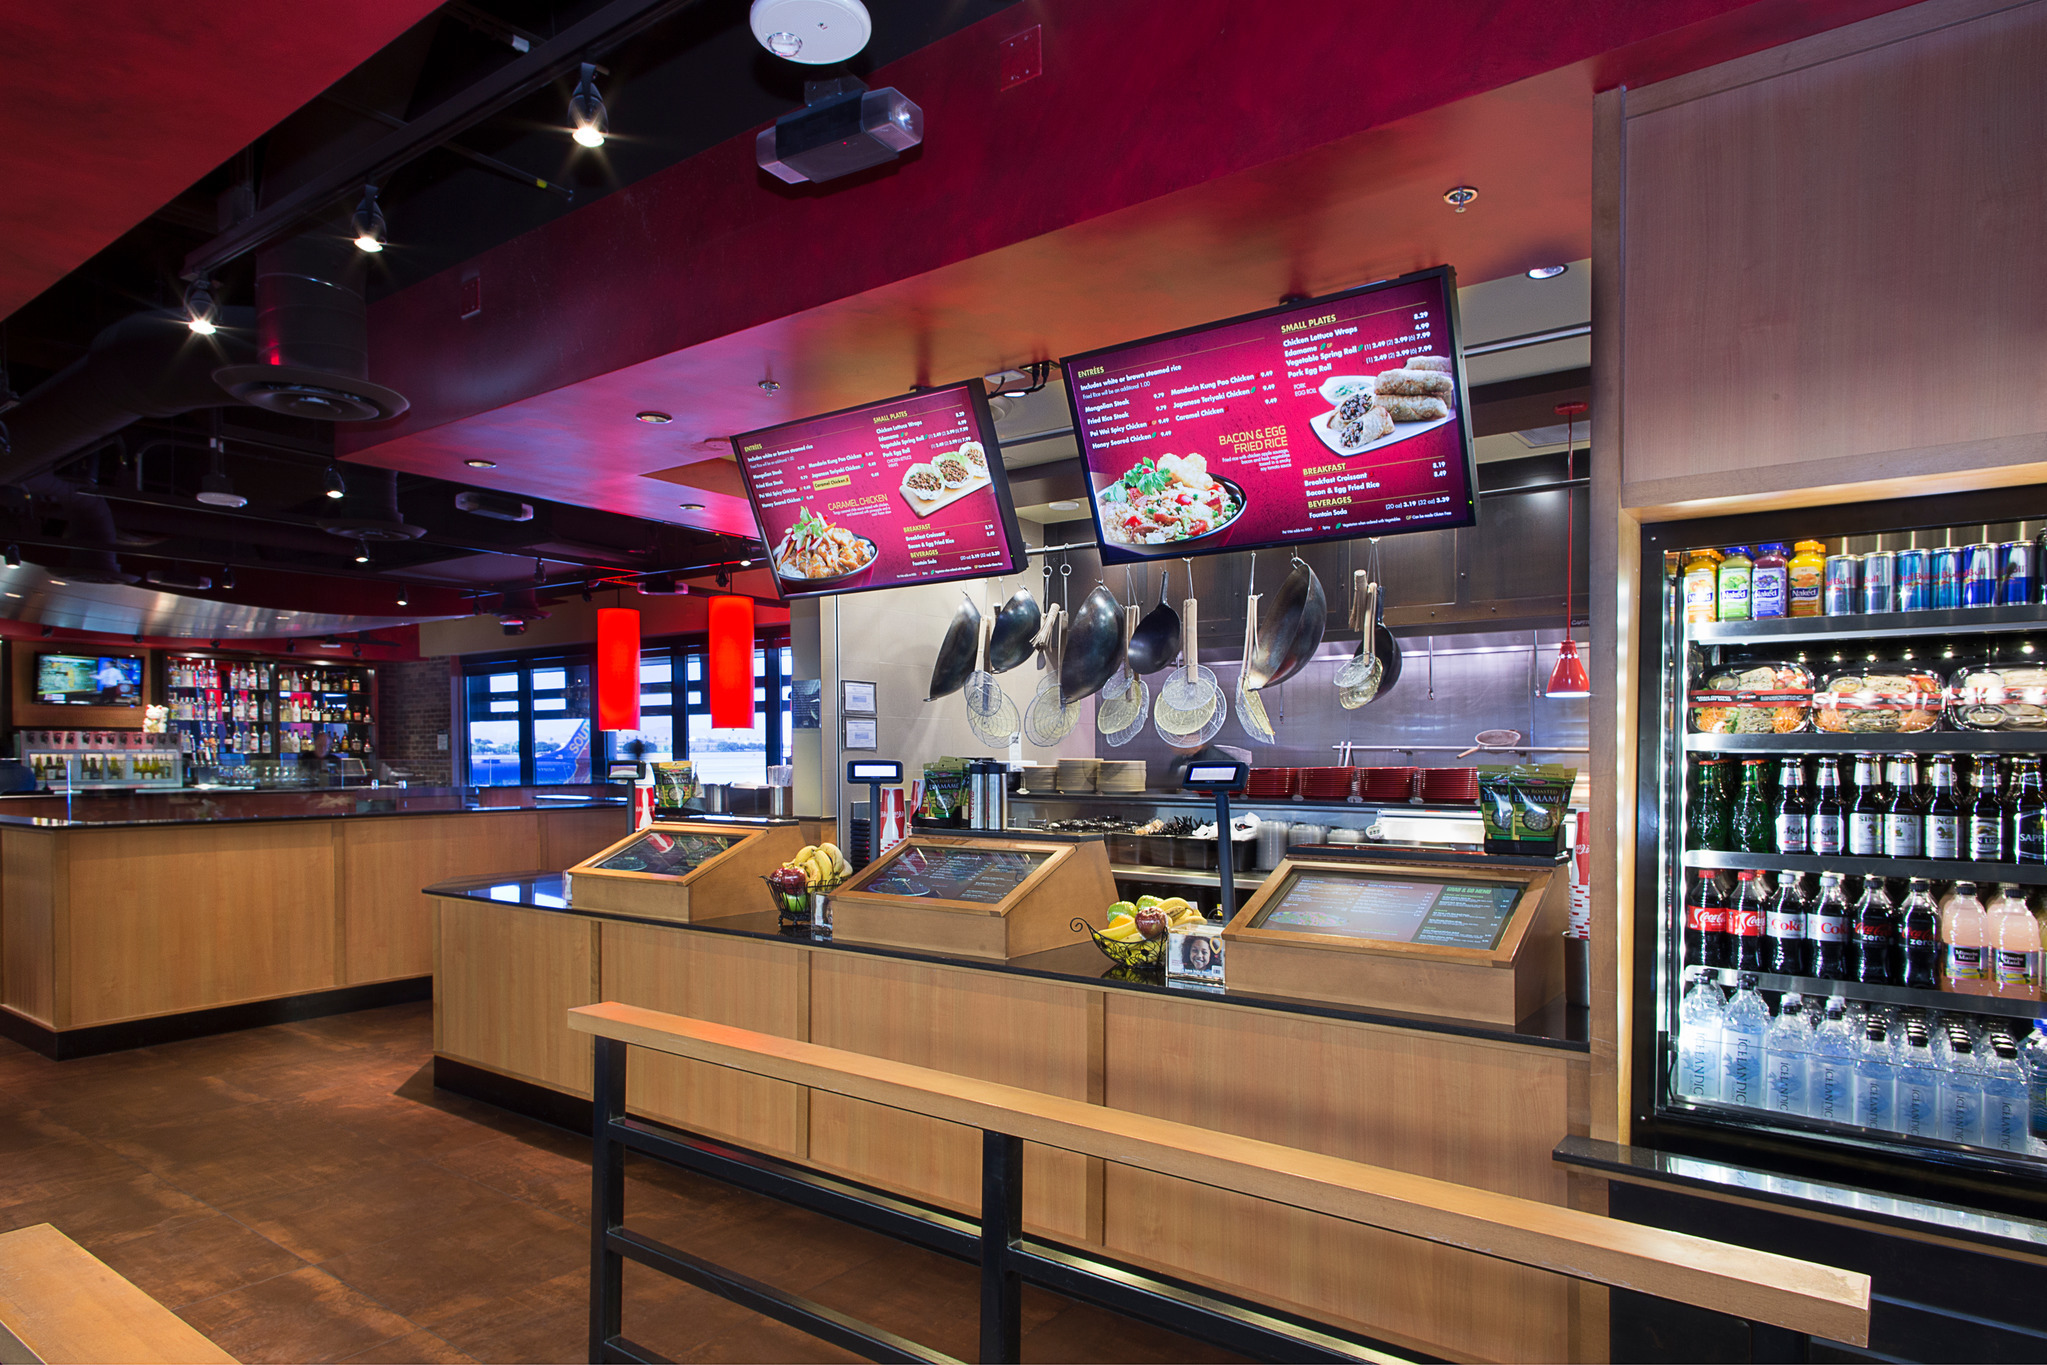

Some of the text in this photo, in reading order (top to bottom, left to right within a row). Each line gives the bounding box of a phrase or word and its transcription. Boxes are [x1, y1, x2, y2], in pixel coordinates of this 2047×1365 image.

[1414, 311, 1428, 320] 8.29
[1281, 314, 1336, 333] SMALL PLATES
[1415, 322, 1430, 330] 4.99
[1283, 327, 1358, 347] Chicken Lettuce Wraps
[1372, 341, 1386, 349] 2.49
[1394, 336, 1408, 344] 3.99
[1416, 331, 1431, 339] 7.99
[1285, 346, 1317, 357] Edamame
[1286, 346, 1357, 367] Vegetable Spring Roll
[1374, 354, 1387, 362] 2.49
[1396, 349, 1410, 357] 3.99
[1418, 345, 1432, 353] 7.99
[1080, 381, 1102, 391] Includes
[1103, 378, 1118, 386] white
[1126, 372, 1145, 381] brown
[1146, 366, 1169, 377] steamed
[1171, 364, 1182, 372] rice
[1288, 363, 1332, 378] Pork Egg Roll
[1171, 384, 1199, 396] Mandarin
[1200, 382, 1217, 390] Kung
[1217, 379, 1229, 387] Pao
[1230, 374, 1254, 384] Chicken
[1085, 403, 1114, 413] Mongolian
[1114, 398, 1130, 407] Steak
[1173, 399, 1200, 409] Japanese
[1201, 393, 1225, 403] Teriyaki
[1226, 389, 1250, 398] Chicken
[873, 411, 908, 423] SMALL PLATES
[1087, 417, 1101, 425] Fried
[1114, 411, 1129, 420] Steak
[1175, 411, 1200, 421] Caramel
[1200, 407, 1224, 416] Chicken
[1089, 430, 1098, 438] Pei
[1111, 426, 1125, 434] Spicy
[1125, 422, 1148, 431] Chicken
[1219, 425, 1286, 445] BACON & EGG
[1092, 441, 1110, 449] Honey
[1110, 437, 1129, 446] Seared
[1130, 433, 1152, 442] Chicken
[1234, 436, 1288, 454] FRIED RICE
[1303, 463, 1346, 476] BREAKFAST
[1304, 472, 1367, 486] Breakfast Croissant
[1306, 488, 1326, 497] Bacon
[1334, 486, 1347, 494] Egg
[1348, 483, 1365, 492] Fried
[828, 499, 859, 511] CARAMEL
[859, 494, 888, 505] CHICKEN
[1308, 496, 1352, 509] BEVERAGES
[1309, 510, 1332, 518] Fountain
[903, 524, 930, 533] BREAKFAST
[910, 549, 938, 558] BEVERAGES
[1862, 934, 1886, 942] zero
